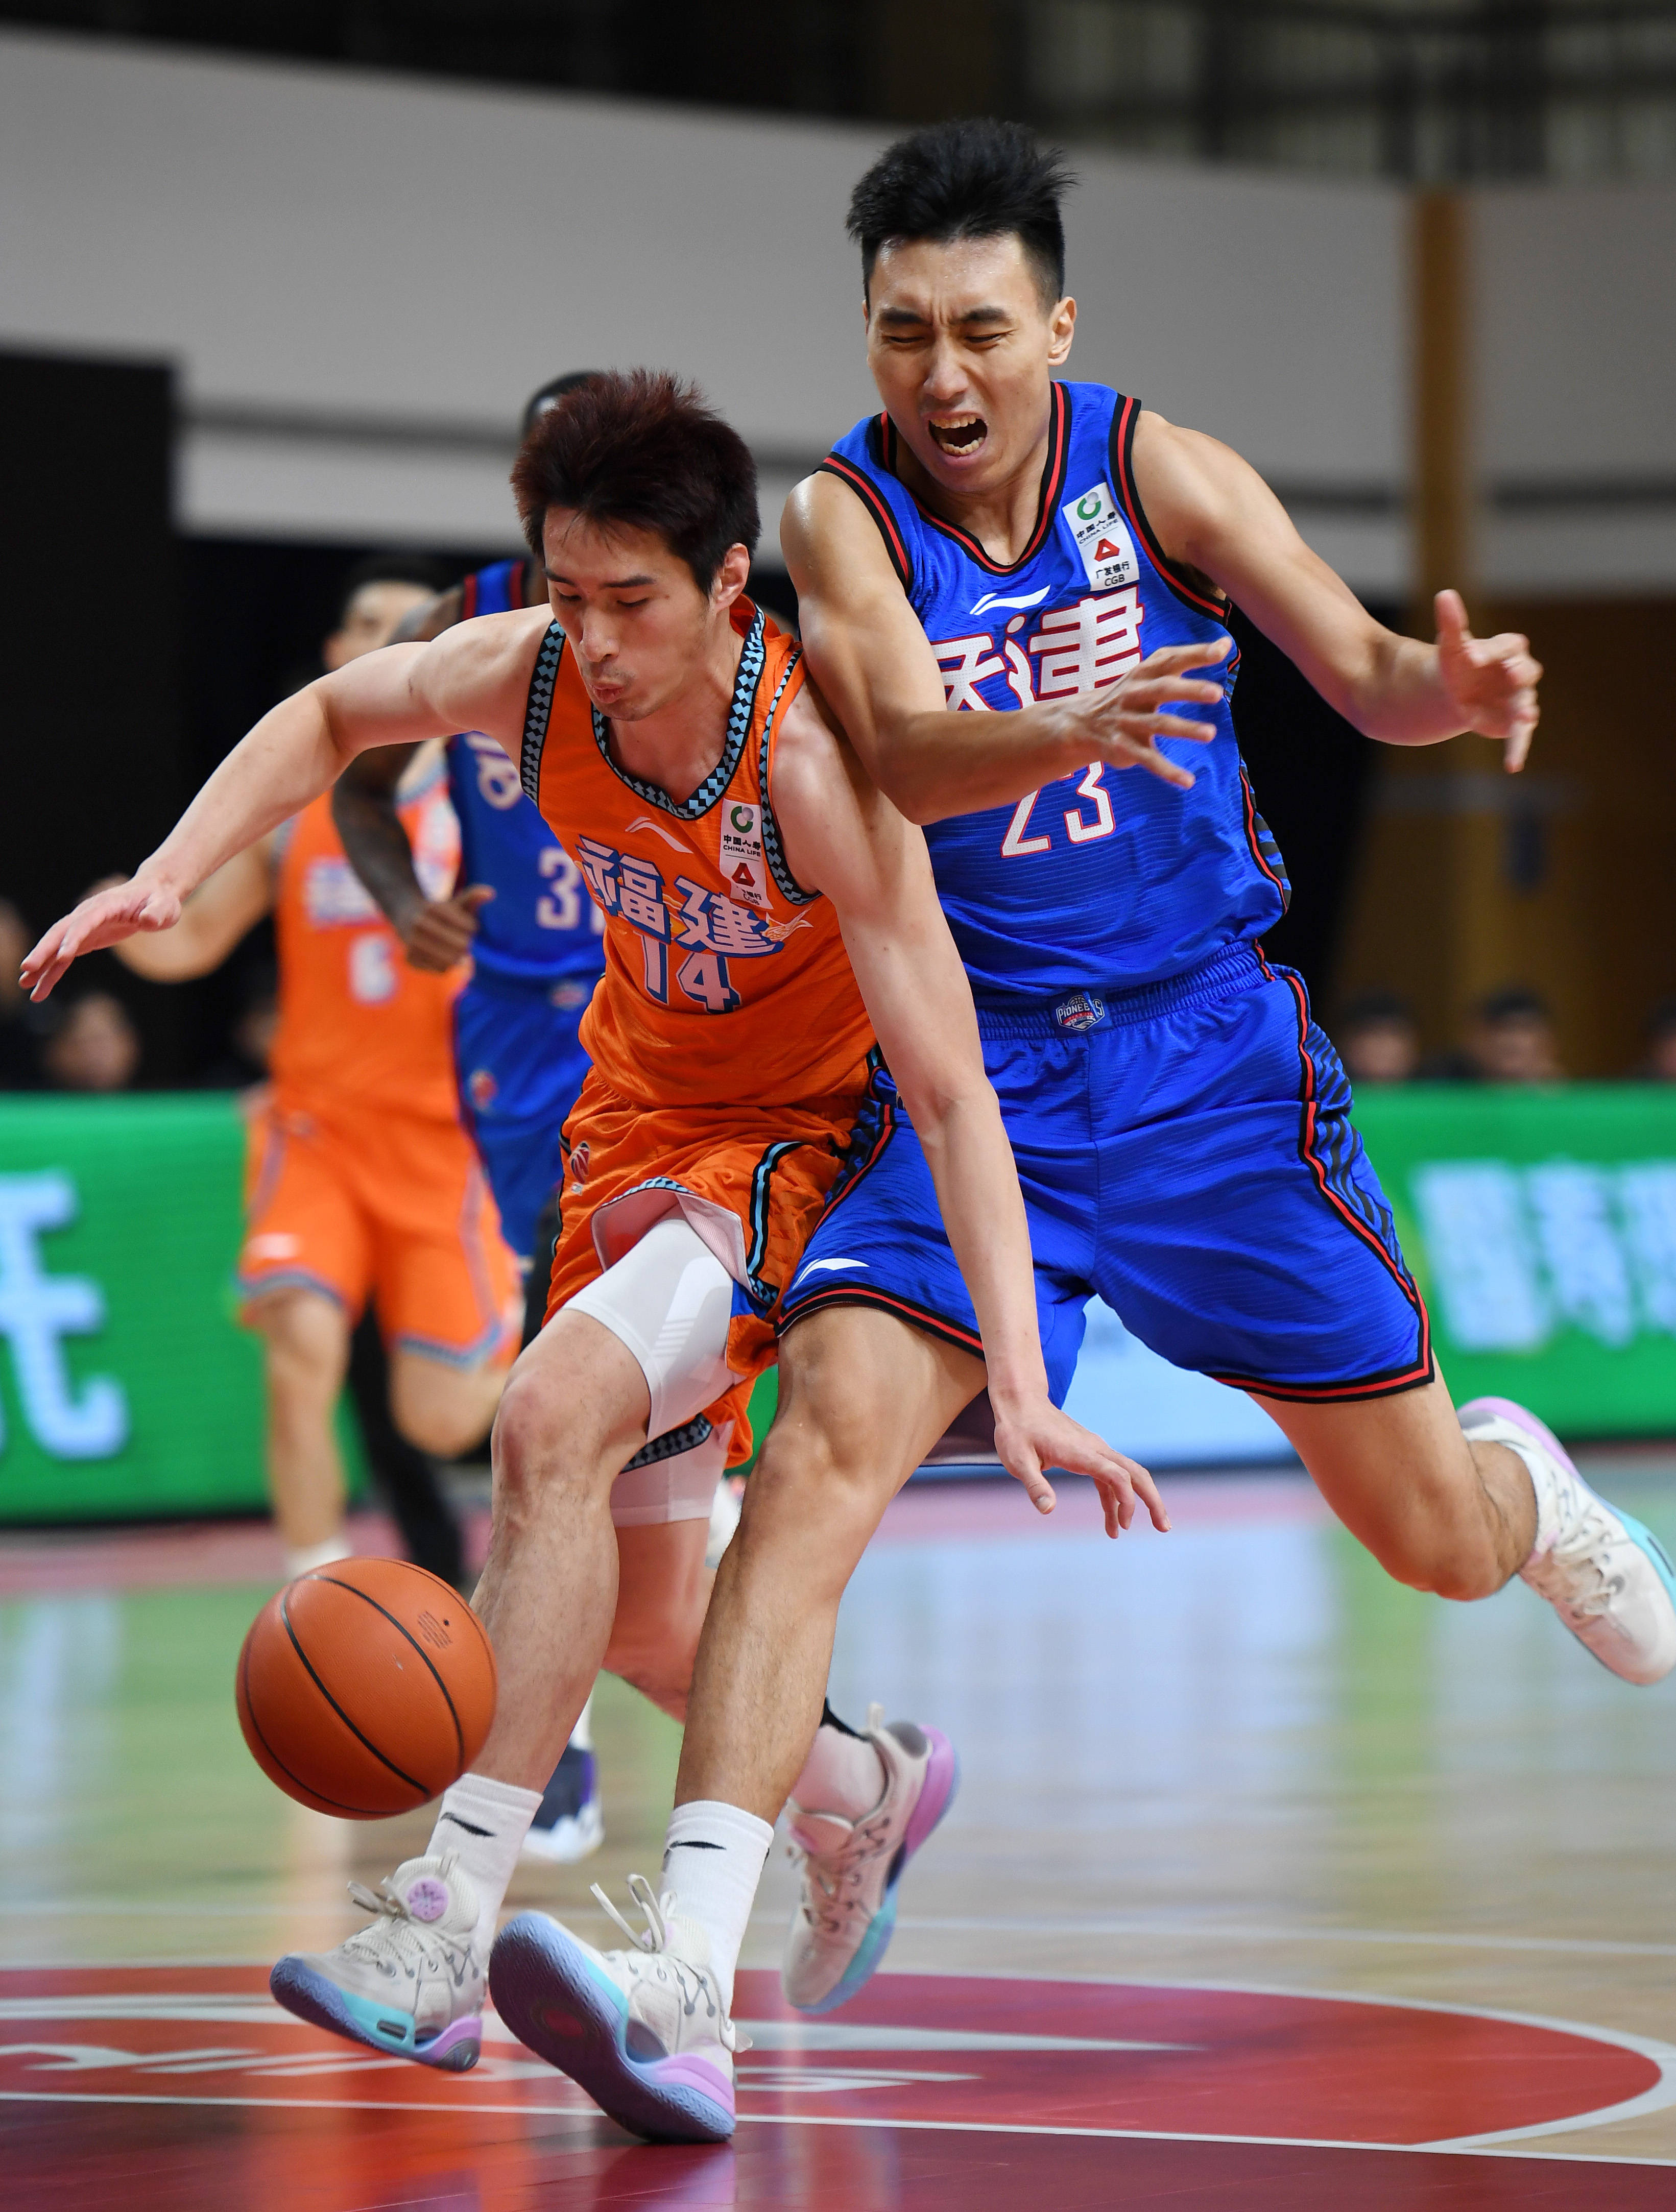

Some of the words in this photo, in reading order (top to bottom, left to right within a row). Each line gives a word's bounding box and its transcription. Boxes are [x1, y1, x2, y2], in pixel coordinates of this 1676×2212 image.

[1076, 511, 1116, 539] 中国人寿
[1079, 529, 1102, 544] CHINA
[1102, 518, 1119, 530] LIFE
[1095, 561, 1130, 579] 广发银行
[1105, 574, 1126, 587] CGB
[1000, 760, 1115, 858] 23
[723, 834, 761, 850] 中国人寿
[723, 845, 745, 853] CHINA
[575, 834, 785, 958] 福建
[639, 934, 743, 1015] 14
[1058, 1000, 1103, 1024] PIONEES
